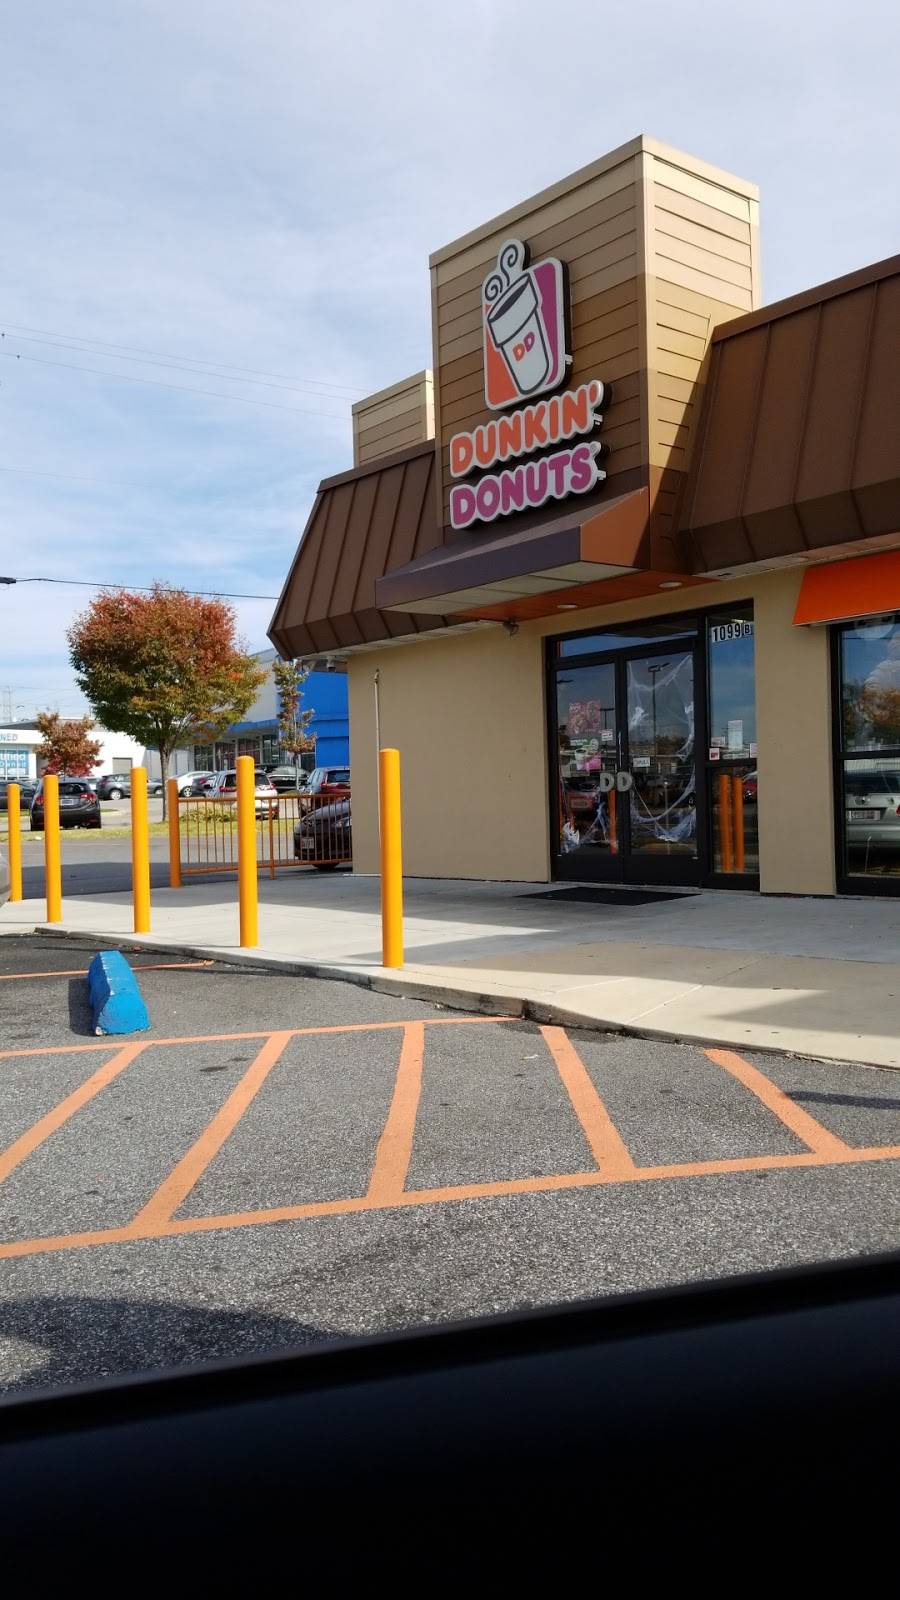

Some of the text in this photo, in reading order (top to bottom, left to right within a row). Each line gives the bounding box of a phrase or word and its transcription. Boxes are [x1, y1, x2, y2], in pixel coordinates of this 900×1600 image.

[512, 331, 535, 362] DD
[451, 383, 598, 475] DUNKIN'
[451, 446, 592, 526] DONUTS
[713, 622, 741, 642] 1099
